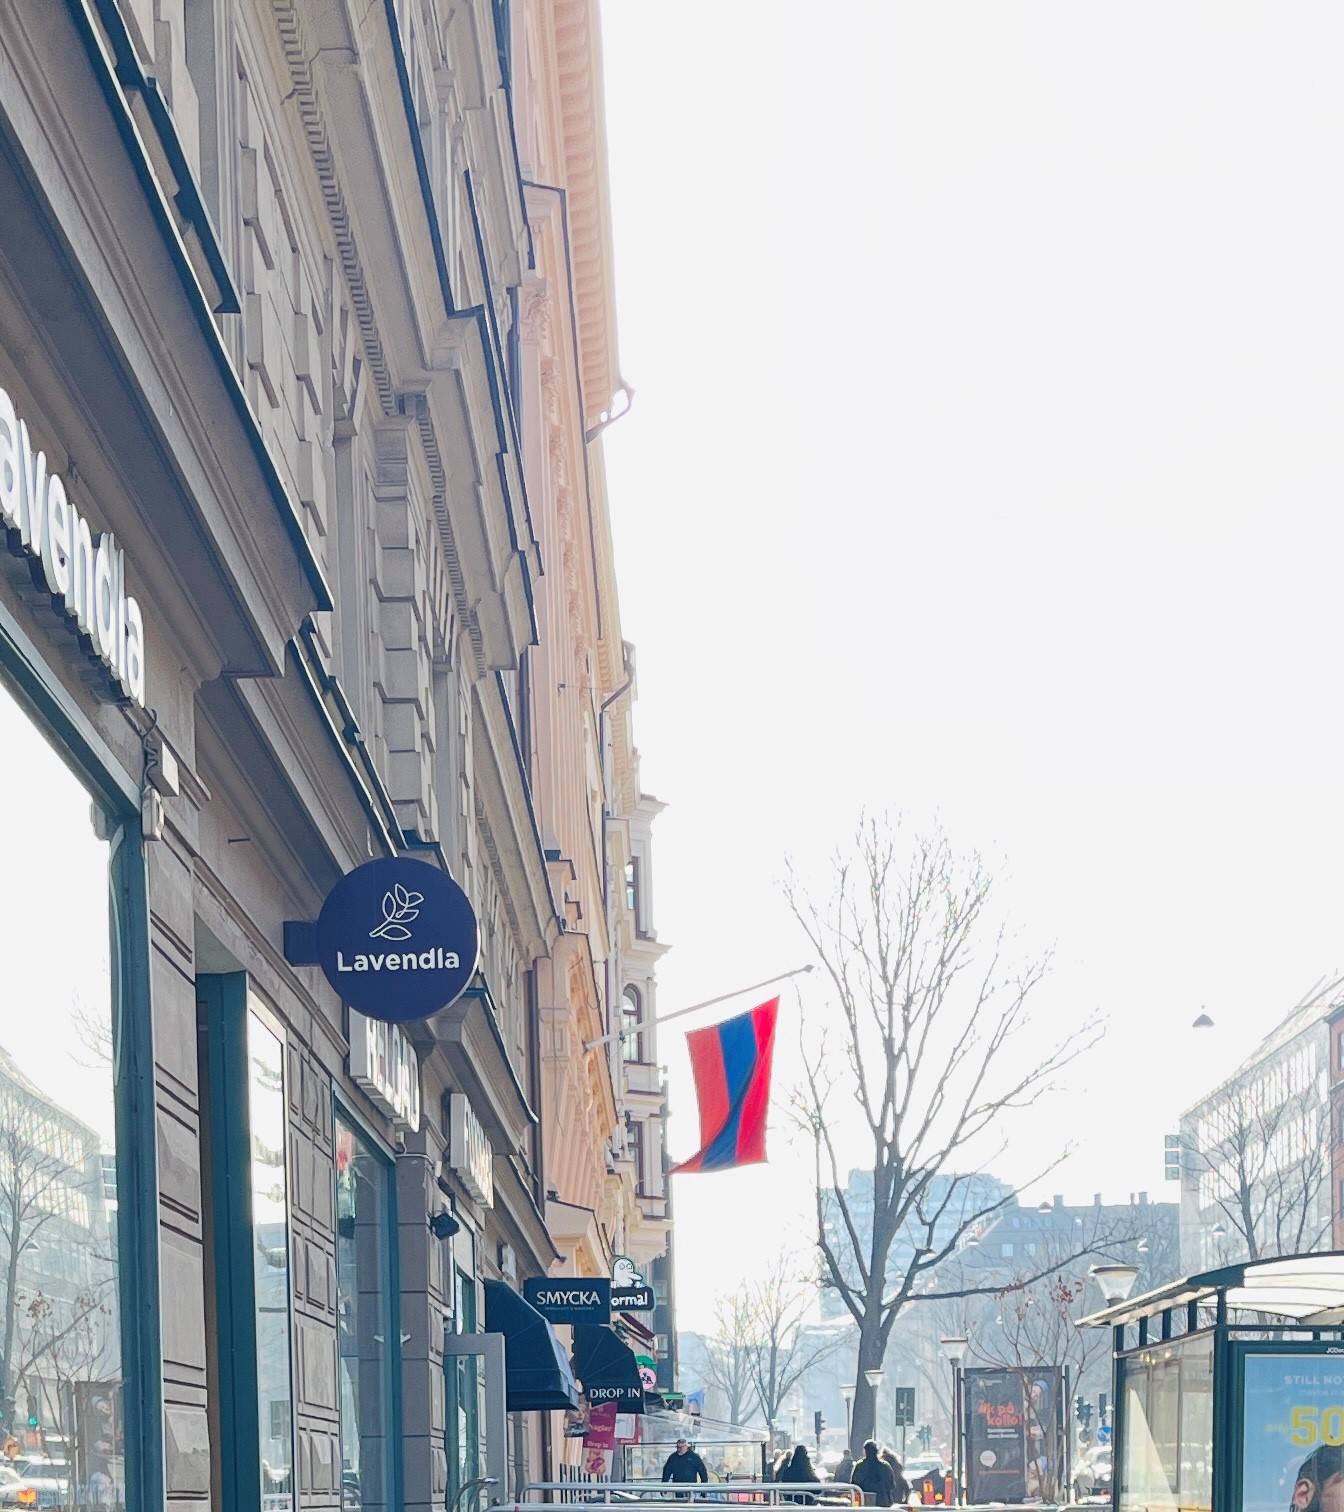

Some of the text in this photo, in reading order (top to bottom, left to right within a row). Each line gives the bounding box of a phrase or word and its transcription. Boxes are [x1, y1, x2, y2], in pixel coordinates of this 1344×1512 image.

[336, 947, 460, 972] Lavendla
[536, 1290, 602, 1305] SMYCKA
[610, 1291, 648, 1307] ormal
[1283, 1375, 1320, 1385] STILL
[589, 1387, 641, 1399] DROP IN
